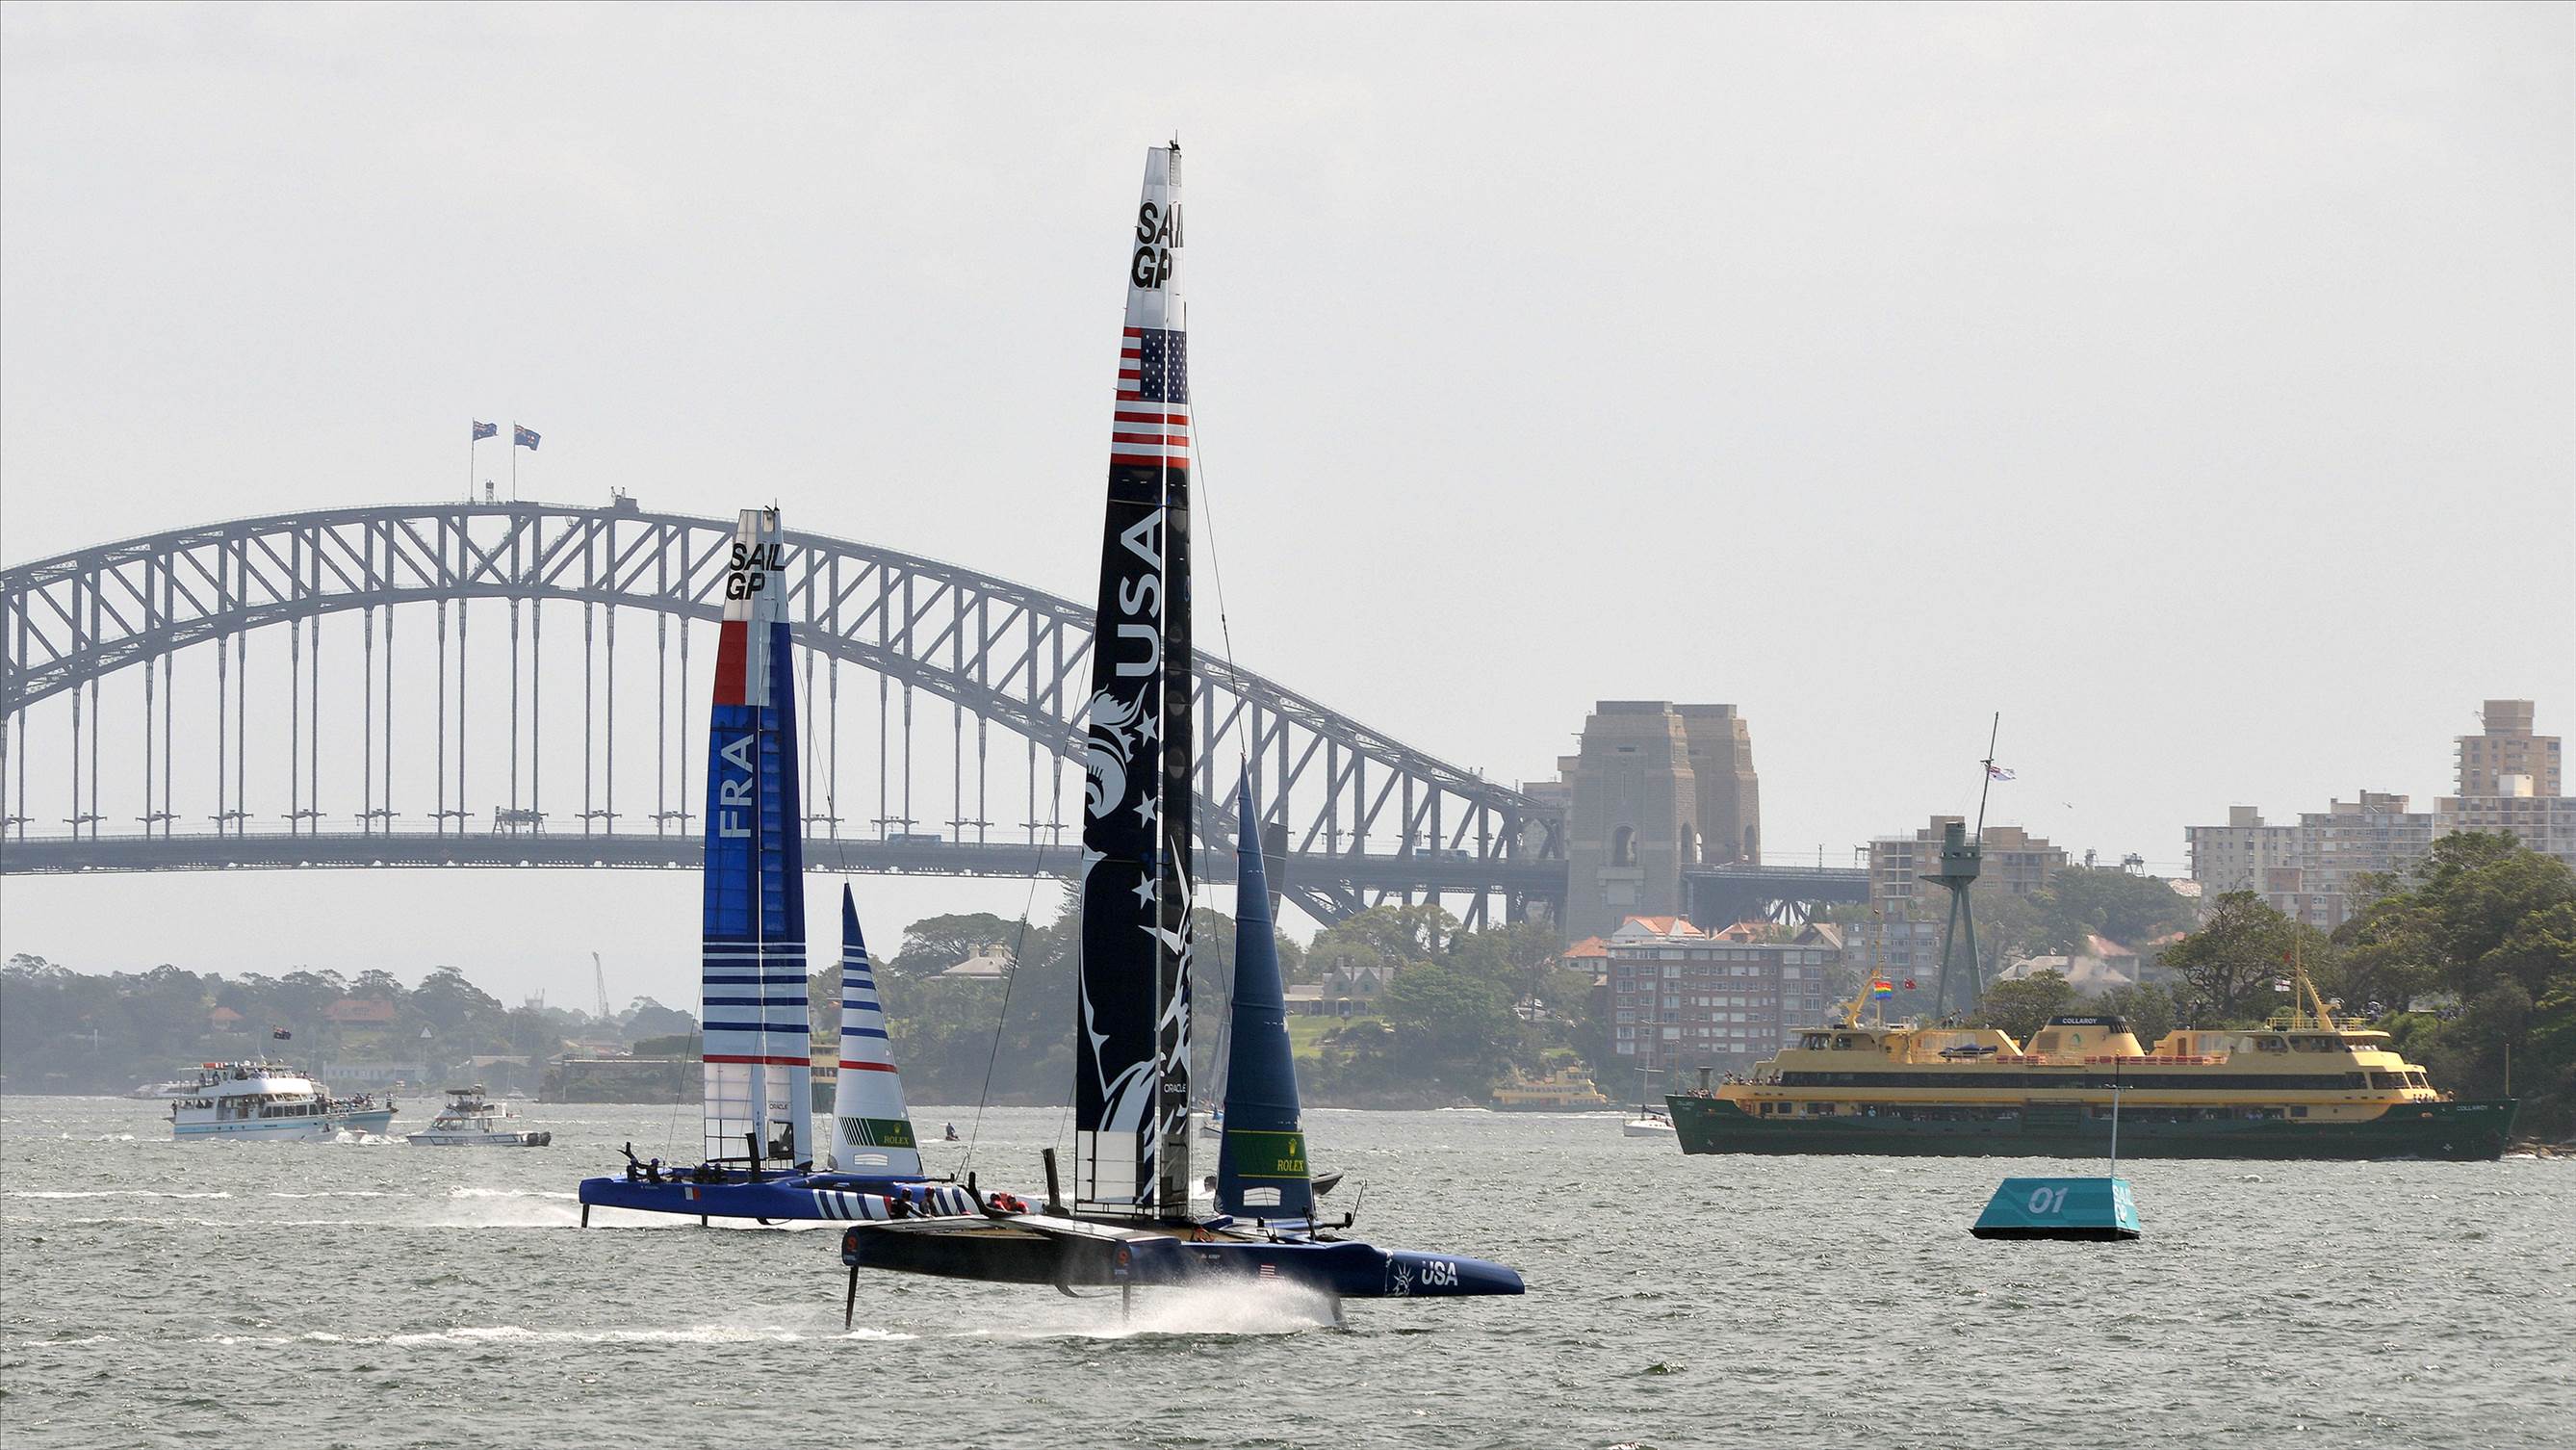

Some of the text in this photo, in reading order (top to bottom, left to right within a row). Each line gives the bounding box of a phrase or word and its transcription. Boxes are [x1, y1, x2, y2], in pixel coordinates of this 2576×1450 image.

[1131, 246, 1172, 288] GP
[730, 543, 786, 571] SAIL
[726, 573, 766, 600] GP
[1116, 508, 1162, 677] USA
[719, 734, 755, 838] FRA
[1164, 1083, 1186, 1093] ORACLE
[884, 1135, 910, 1146] ROLEX
[1277, 1159, 1303, 1172] ROLEX
[2028, 1187, 2069, 1214] 01
[1421, 1260, 1458, 1286] USA
